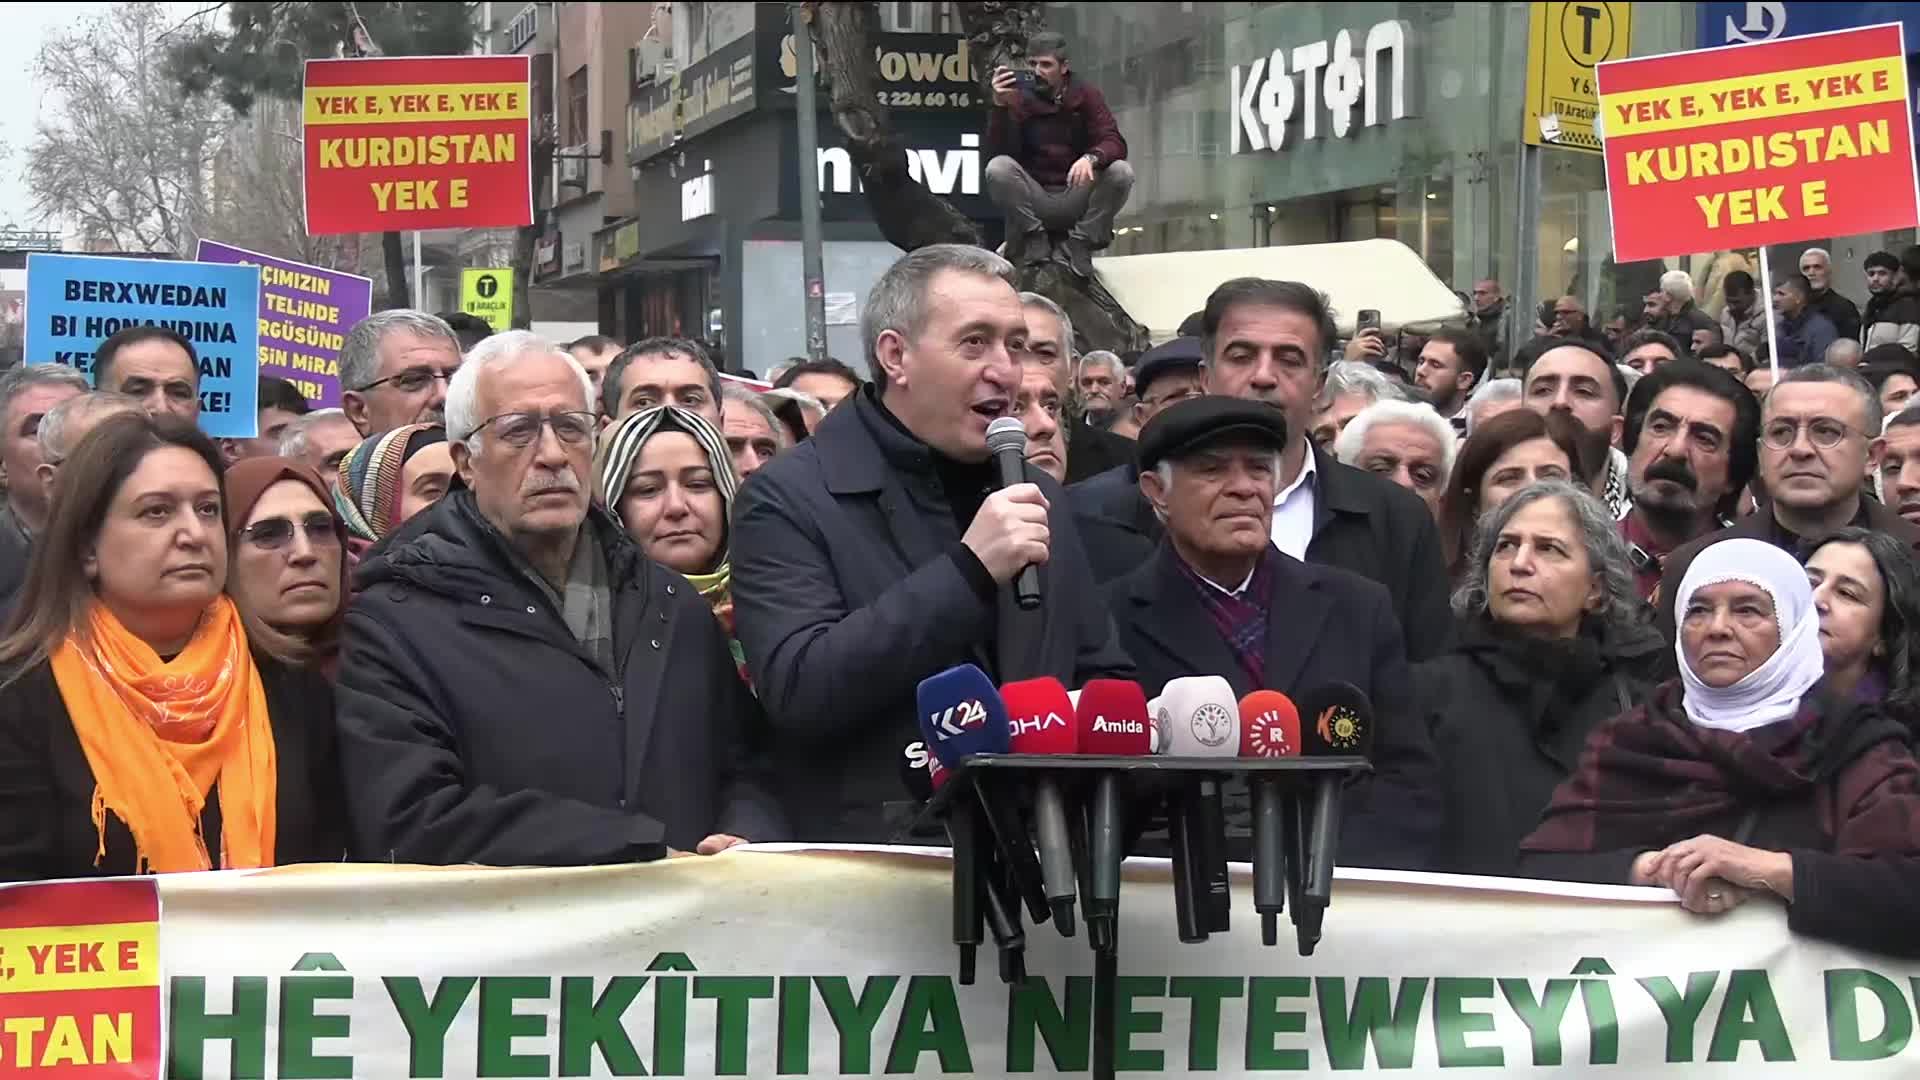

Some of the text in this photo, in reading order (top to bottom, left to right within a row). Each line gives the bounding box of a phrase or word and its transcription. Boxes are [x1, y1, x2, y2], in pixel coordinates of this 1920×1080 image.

[1576, 5, 1600, 55] T
[316, 92, 517, 115] YEK E, YEK E, YEK E
[891, 91, 922, 106] 224
[924, 91, 946, 107] 60
[950, 92, 970, 107] 16
[1616, 70, 1889, 125] YEK E, YEK E, YEK E
[319, 133, 516, 168] KURDISTAN
[1625, 119, 1891, 186] KURDISTAN
[370, 179, 469, 211] YEK E
[1695, 180, 1829, 229] YEK E
[64, 279, 227, 308] BERXWEDAN
[480, 278, 494, 296] T
[51, 315, 237, 344] BI HODINA
[258, 318, 344, 351] RGÜSÜND
[1092, 715, 1144, 733] Amida
[1270, 727, 1284, 742] R
[27, 942, 105, 975] YEK
[118, 941, 139, 970] E
[168, 951, 1920, 1080] HÊ YEKÎTIYA NETEWEYÎ YA D
